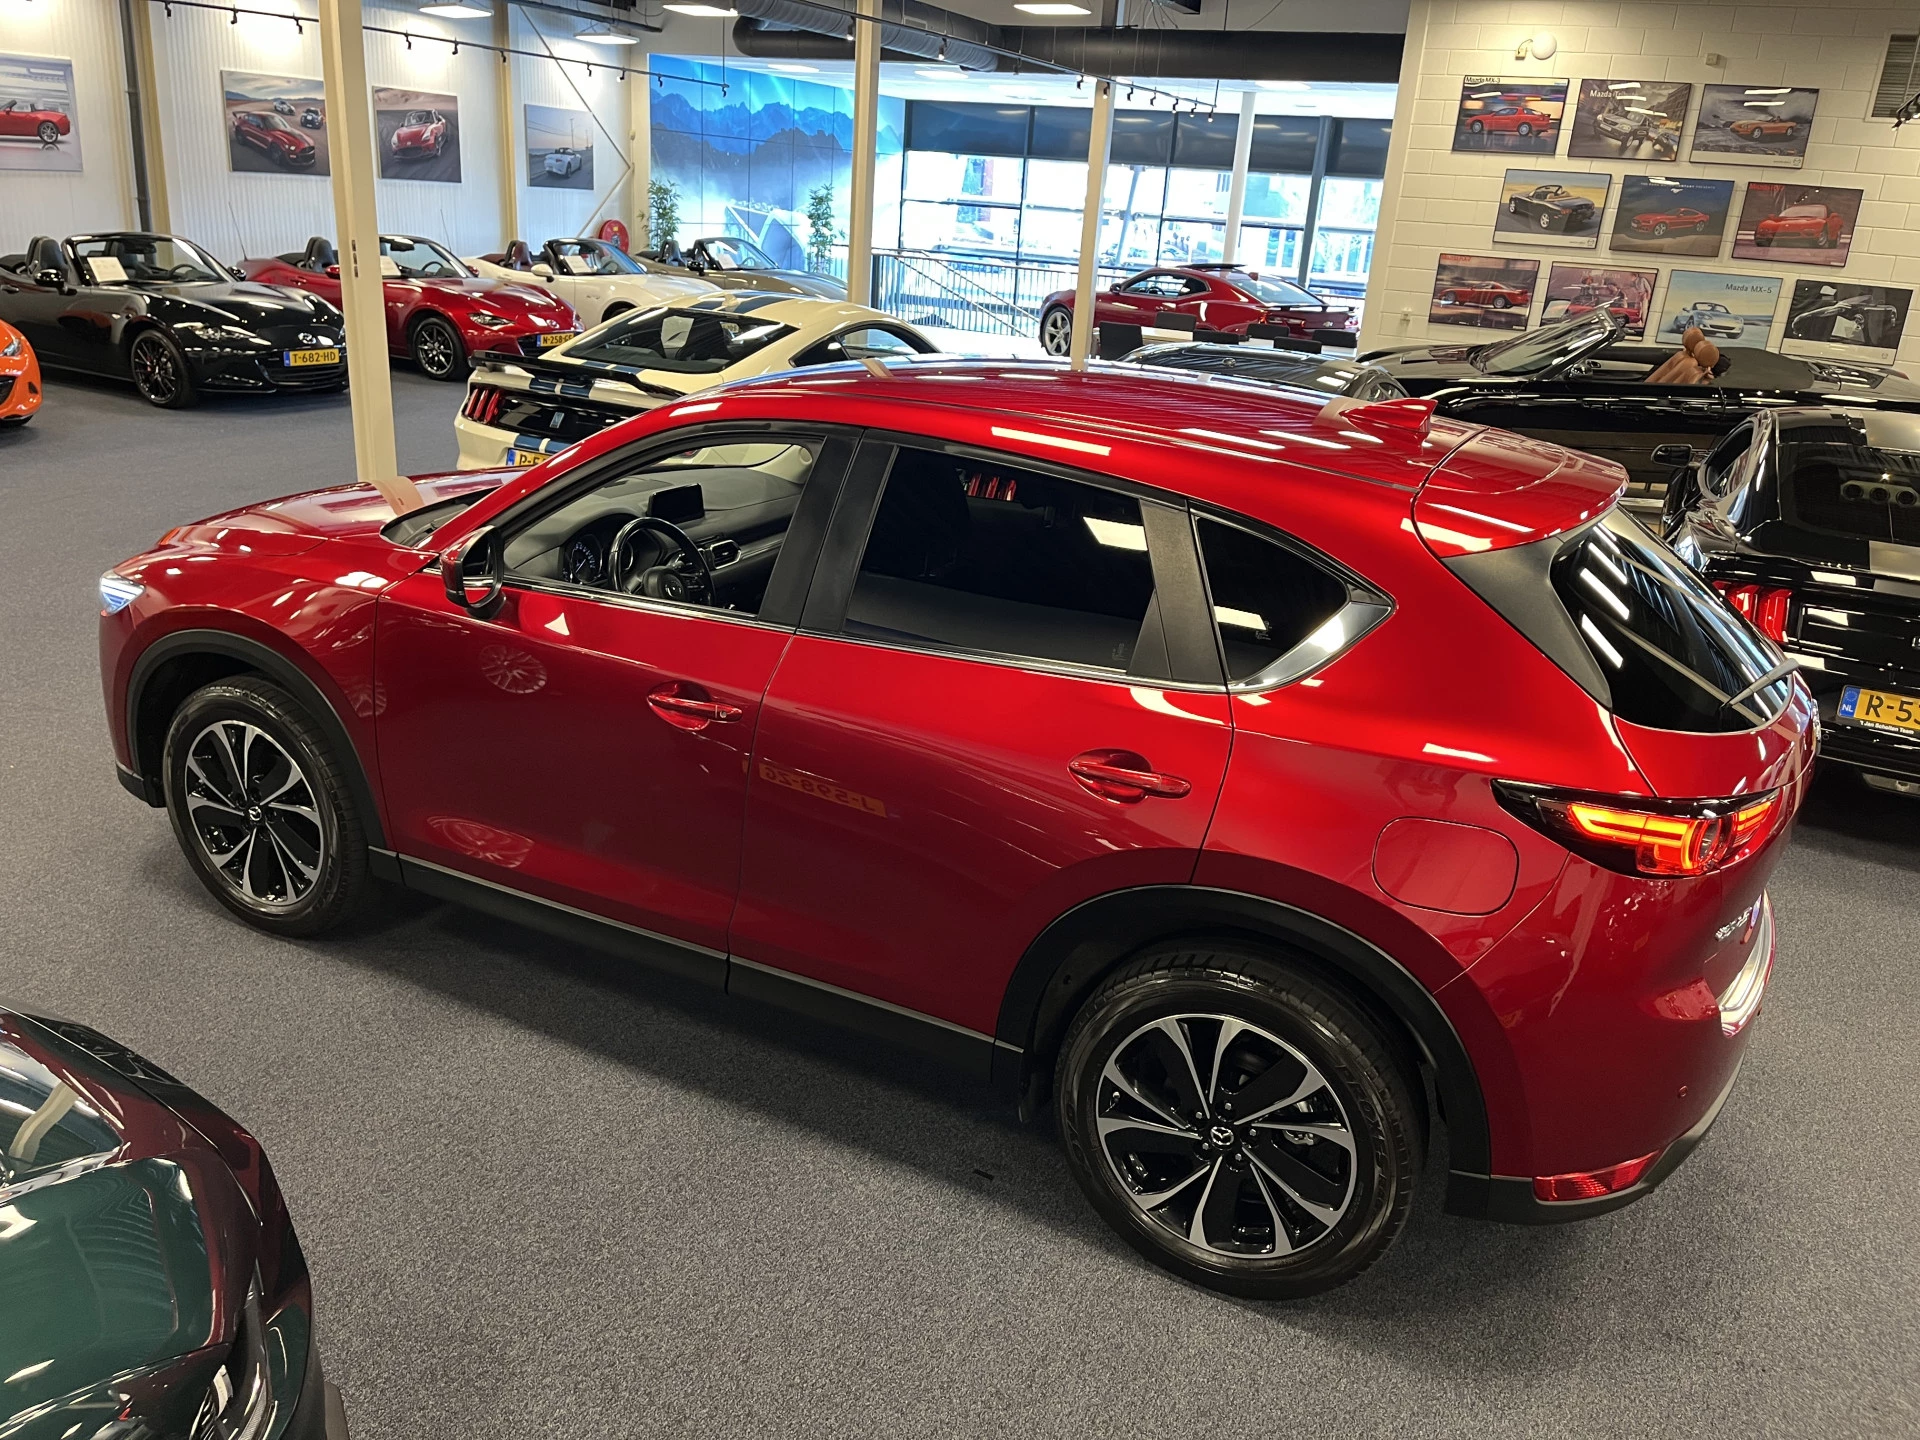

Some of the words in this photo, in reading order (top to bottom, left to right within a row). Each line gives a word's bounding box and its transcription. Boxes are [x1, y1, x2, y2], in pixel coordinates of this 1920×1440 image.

[1589, 89, 1612, 98] Mazda
[1725, 283, 1749, 292] Mazda
[1750, 285, 1772, 294] MX-5
[291, 350, 337, 364] T-682-HD
[1841, 703, 1854, 713] NL
[1899, 727, 1915, 735] Team
